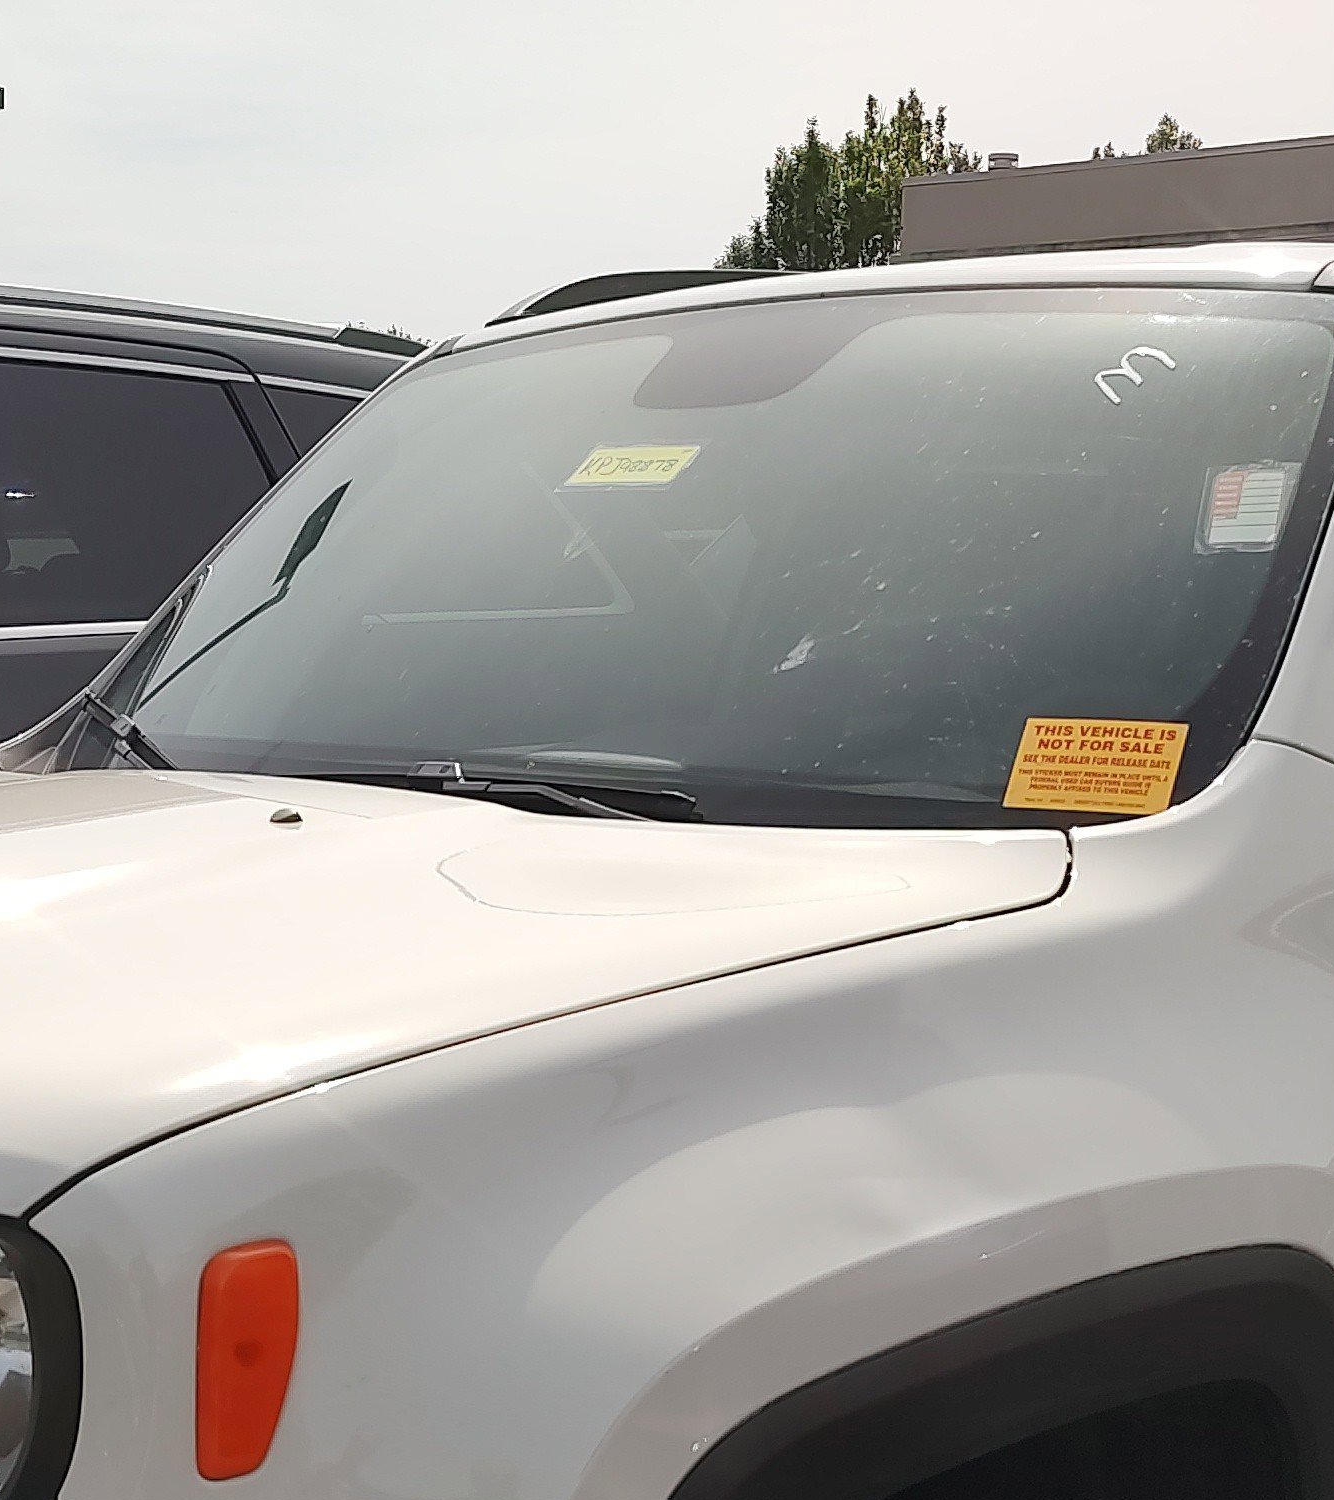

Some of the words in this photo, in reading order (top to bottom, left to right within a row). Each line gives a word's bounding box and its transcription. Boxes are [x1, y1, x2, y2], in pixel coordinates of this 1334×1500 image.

[1034, 725, 1074, 737] THIS
[1080, 725, 1155, 740] VEHICLE
[1159, 729, 1177, 741] IS
[1037, 738, 1074, 751] NOT
[1079, 739, 1114, 752] FOR
[1119, 741, 1165, 754] SALE
[1022, 754, 1039, 763] SEE
[1041, 754, 1057, 763] THE
[1058, 755, 1090, 765] DEALER
[1092, 756, 1109, 766] FOR
[1110, 757, 1148, 768] RELEASE
[1149, 759, 1171, 770] DATE
